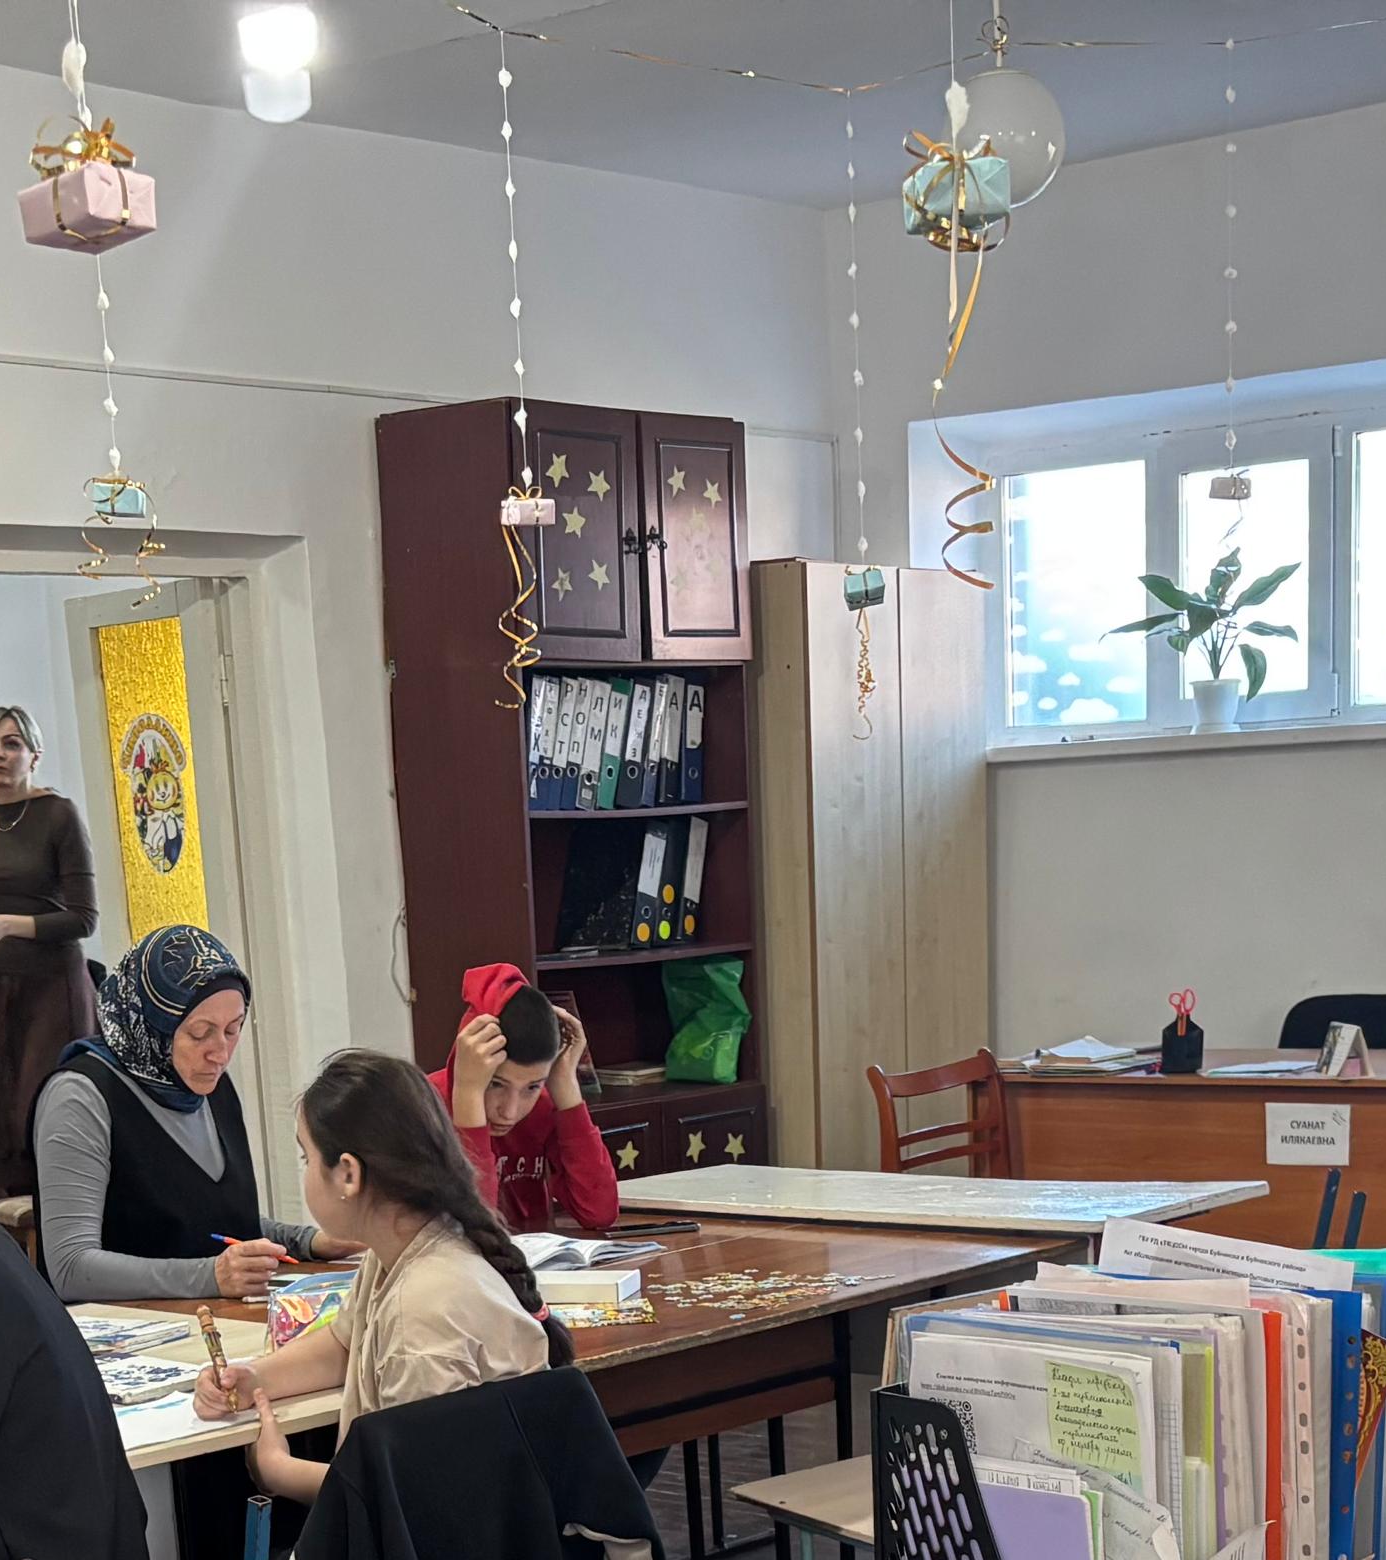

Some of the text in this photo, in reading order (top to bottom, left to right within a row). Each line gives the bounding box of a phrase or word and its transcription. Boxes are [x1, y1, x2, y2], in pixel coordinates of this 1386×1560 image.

[578, 683, 588, 699] Н
[669, 691, 679, 712] А
[689, 690, 703, 713] А
[557, 683, 574, 755] Р С Т
[589, 697, 604, 742] Л М
[609, 696, 623, 739] И К
[572, 741, 580, 753] П
[1290, 1120, 1326, 1130] СУАНАТ
